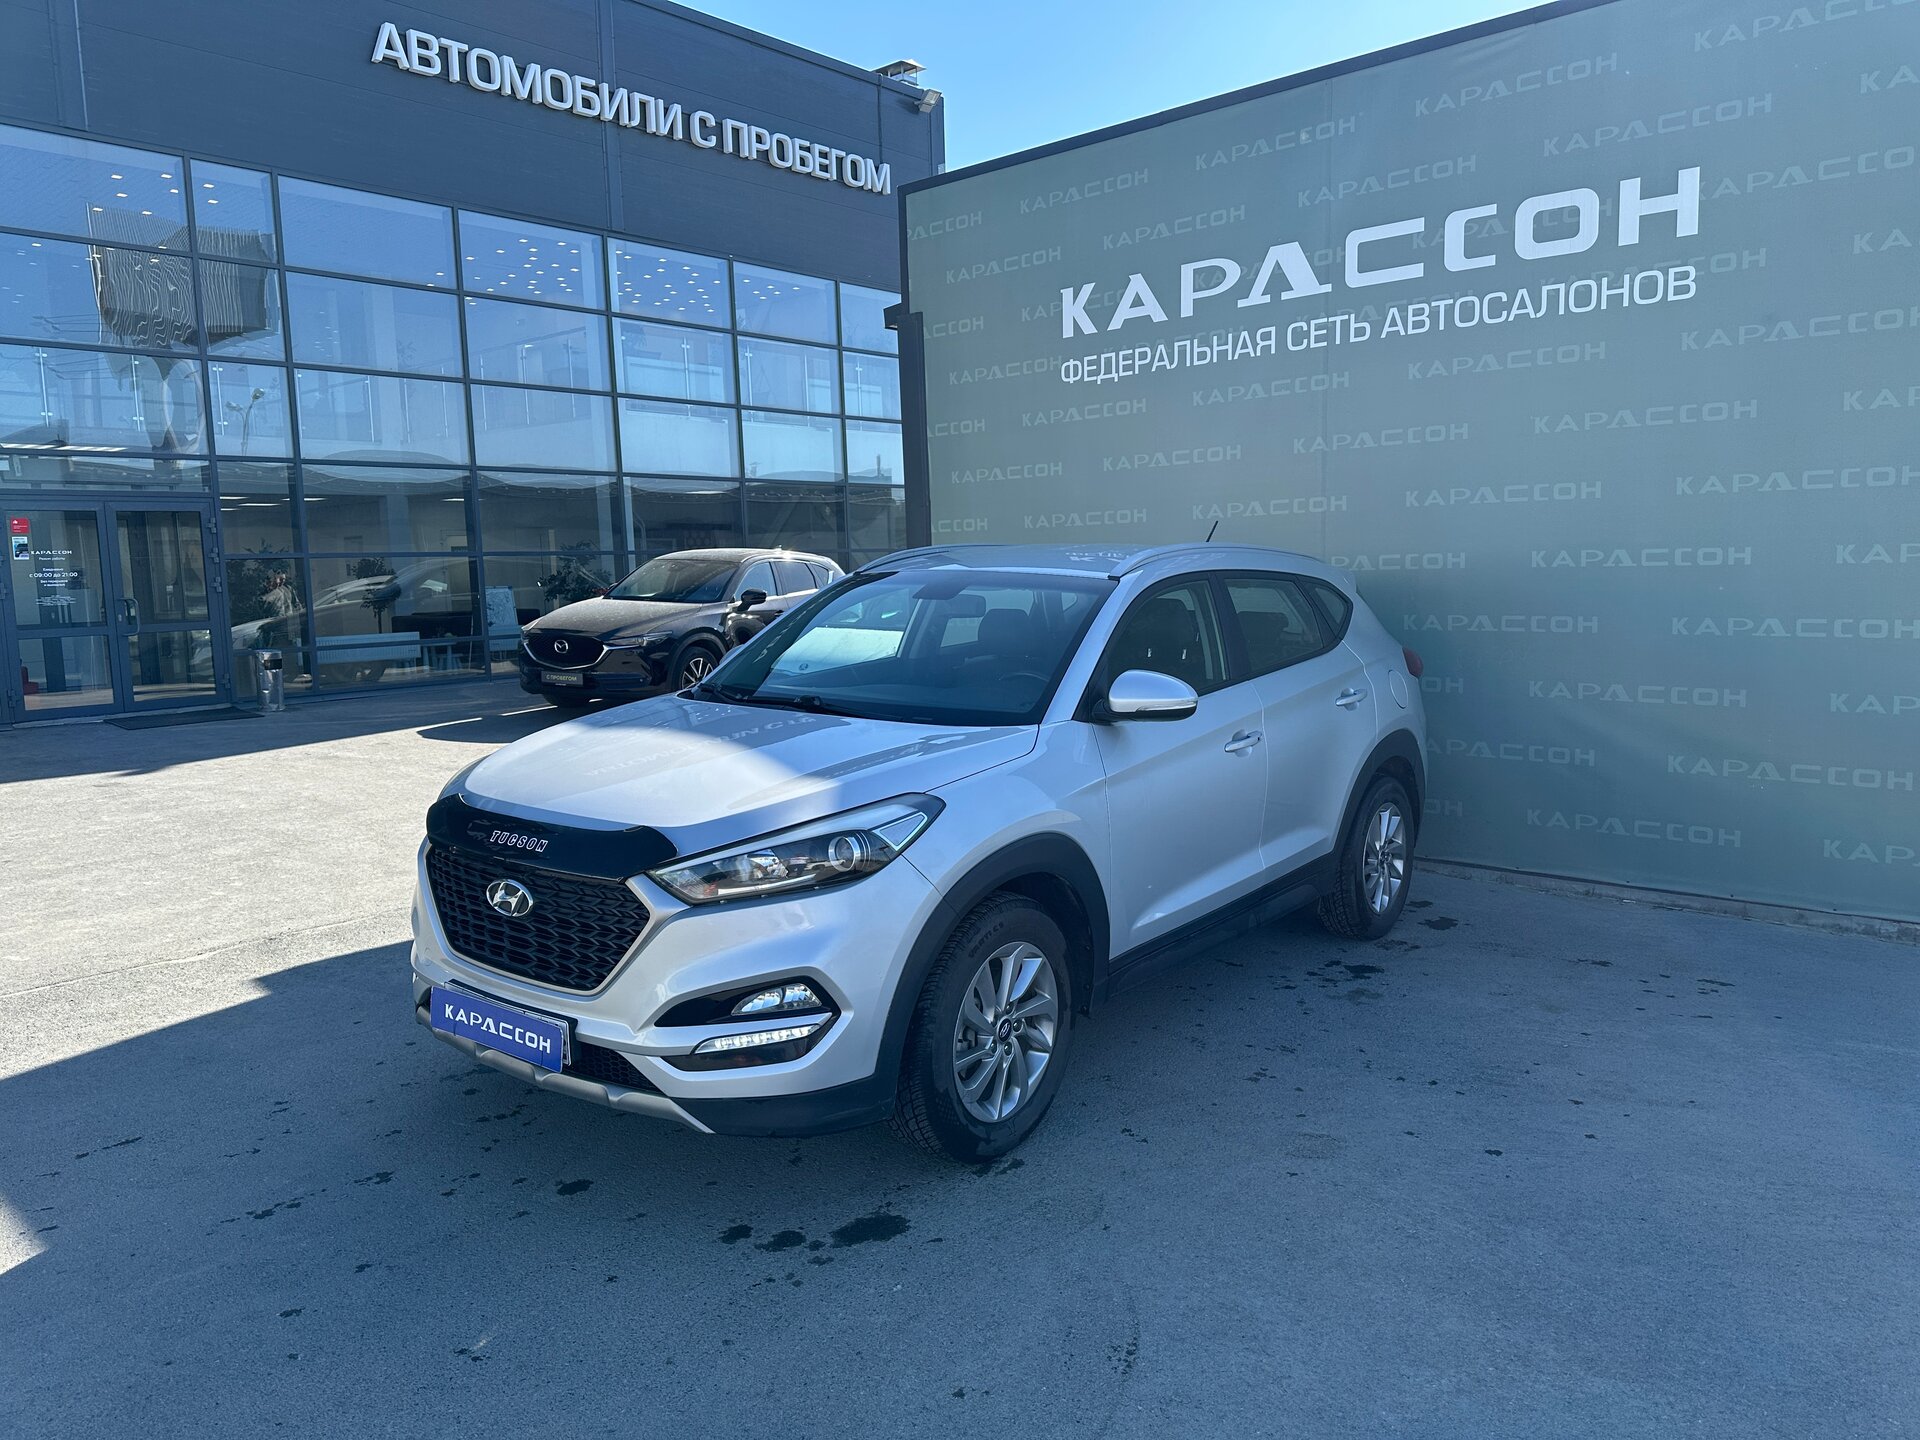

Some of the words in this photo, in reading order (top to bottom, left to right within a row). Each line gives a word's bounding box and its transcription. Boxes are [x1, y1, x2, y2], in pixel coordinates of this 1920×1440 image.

[1415, 52, 1618, 118] КАРАССОН
[371, 21, 683, 141] АВТОМОБИЛИ
[690, 110, 717, 149] С
[722, 118, 891, 196] ПРОБЕГОМ
[1543, 93, 1773, 157] КАРАССОН
[1196, 116, 1355, 170] КАРАССОН
[1020, 168, 1149, 214] КАРАССОН
[1298, 154, 1476, 208] КАРАССОН
[1103, 204, 1245, 250] КАРАССОН
[946, 246, 1061, 284] КАРАССОН
[1061, 166, 1701, 339] КАРАССОН
[1061, 326, 1276, 385] ФЕДЕРАЛЬНАЯ
[1286, 313, 1371, 352] СЕТЬ
[1380, 265, 1697, 339] АВТОСАЛОНОВ
[1408, 342, 1606, 380] КАРАССОН
[1193, 371, 1349, 407] КАРАССОН
[1022, 398, 1147, 428] КАРАССОН
[1534, 400, 1758, 434] КАРАССОН
[1293, 423, 1469, 454] КАРАССОН
[951, 462, 1062, 484] КАРАССОН
[1103, 445, 1242, 472] КАРАССОН
[1192, 495, 1347, 521] КАРАССОН
[1405, 481, 1602, 507] КАРАССОН
[1024, 508, 1147, 529] КАРАССОН
[1531, 546, 1752, 568] КАРАССОН
[1403, 614, 1598, 634] КАРАССОН
[1529, 680, 1748, 708] КАРАССОН
[1667, 755, 1913, 790] КАРАССОН
[489, 830, 549, 853] TUCSON
[1527, 808, 1741, 848] КАРАССОН
[444, 1003, 551, 1054] КАРАССОН
